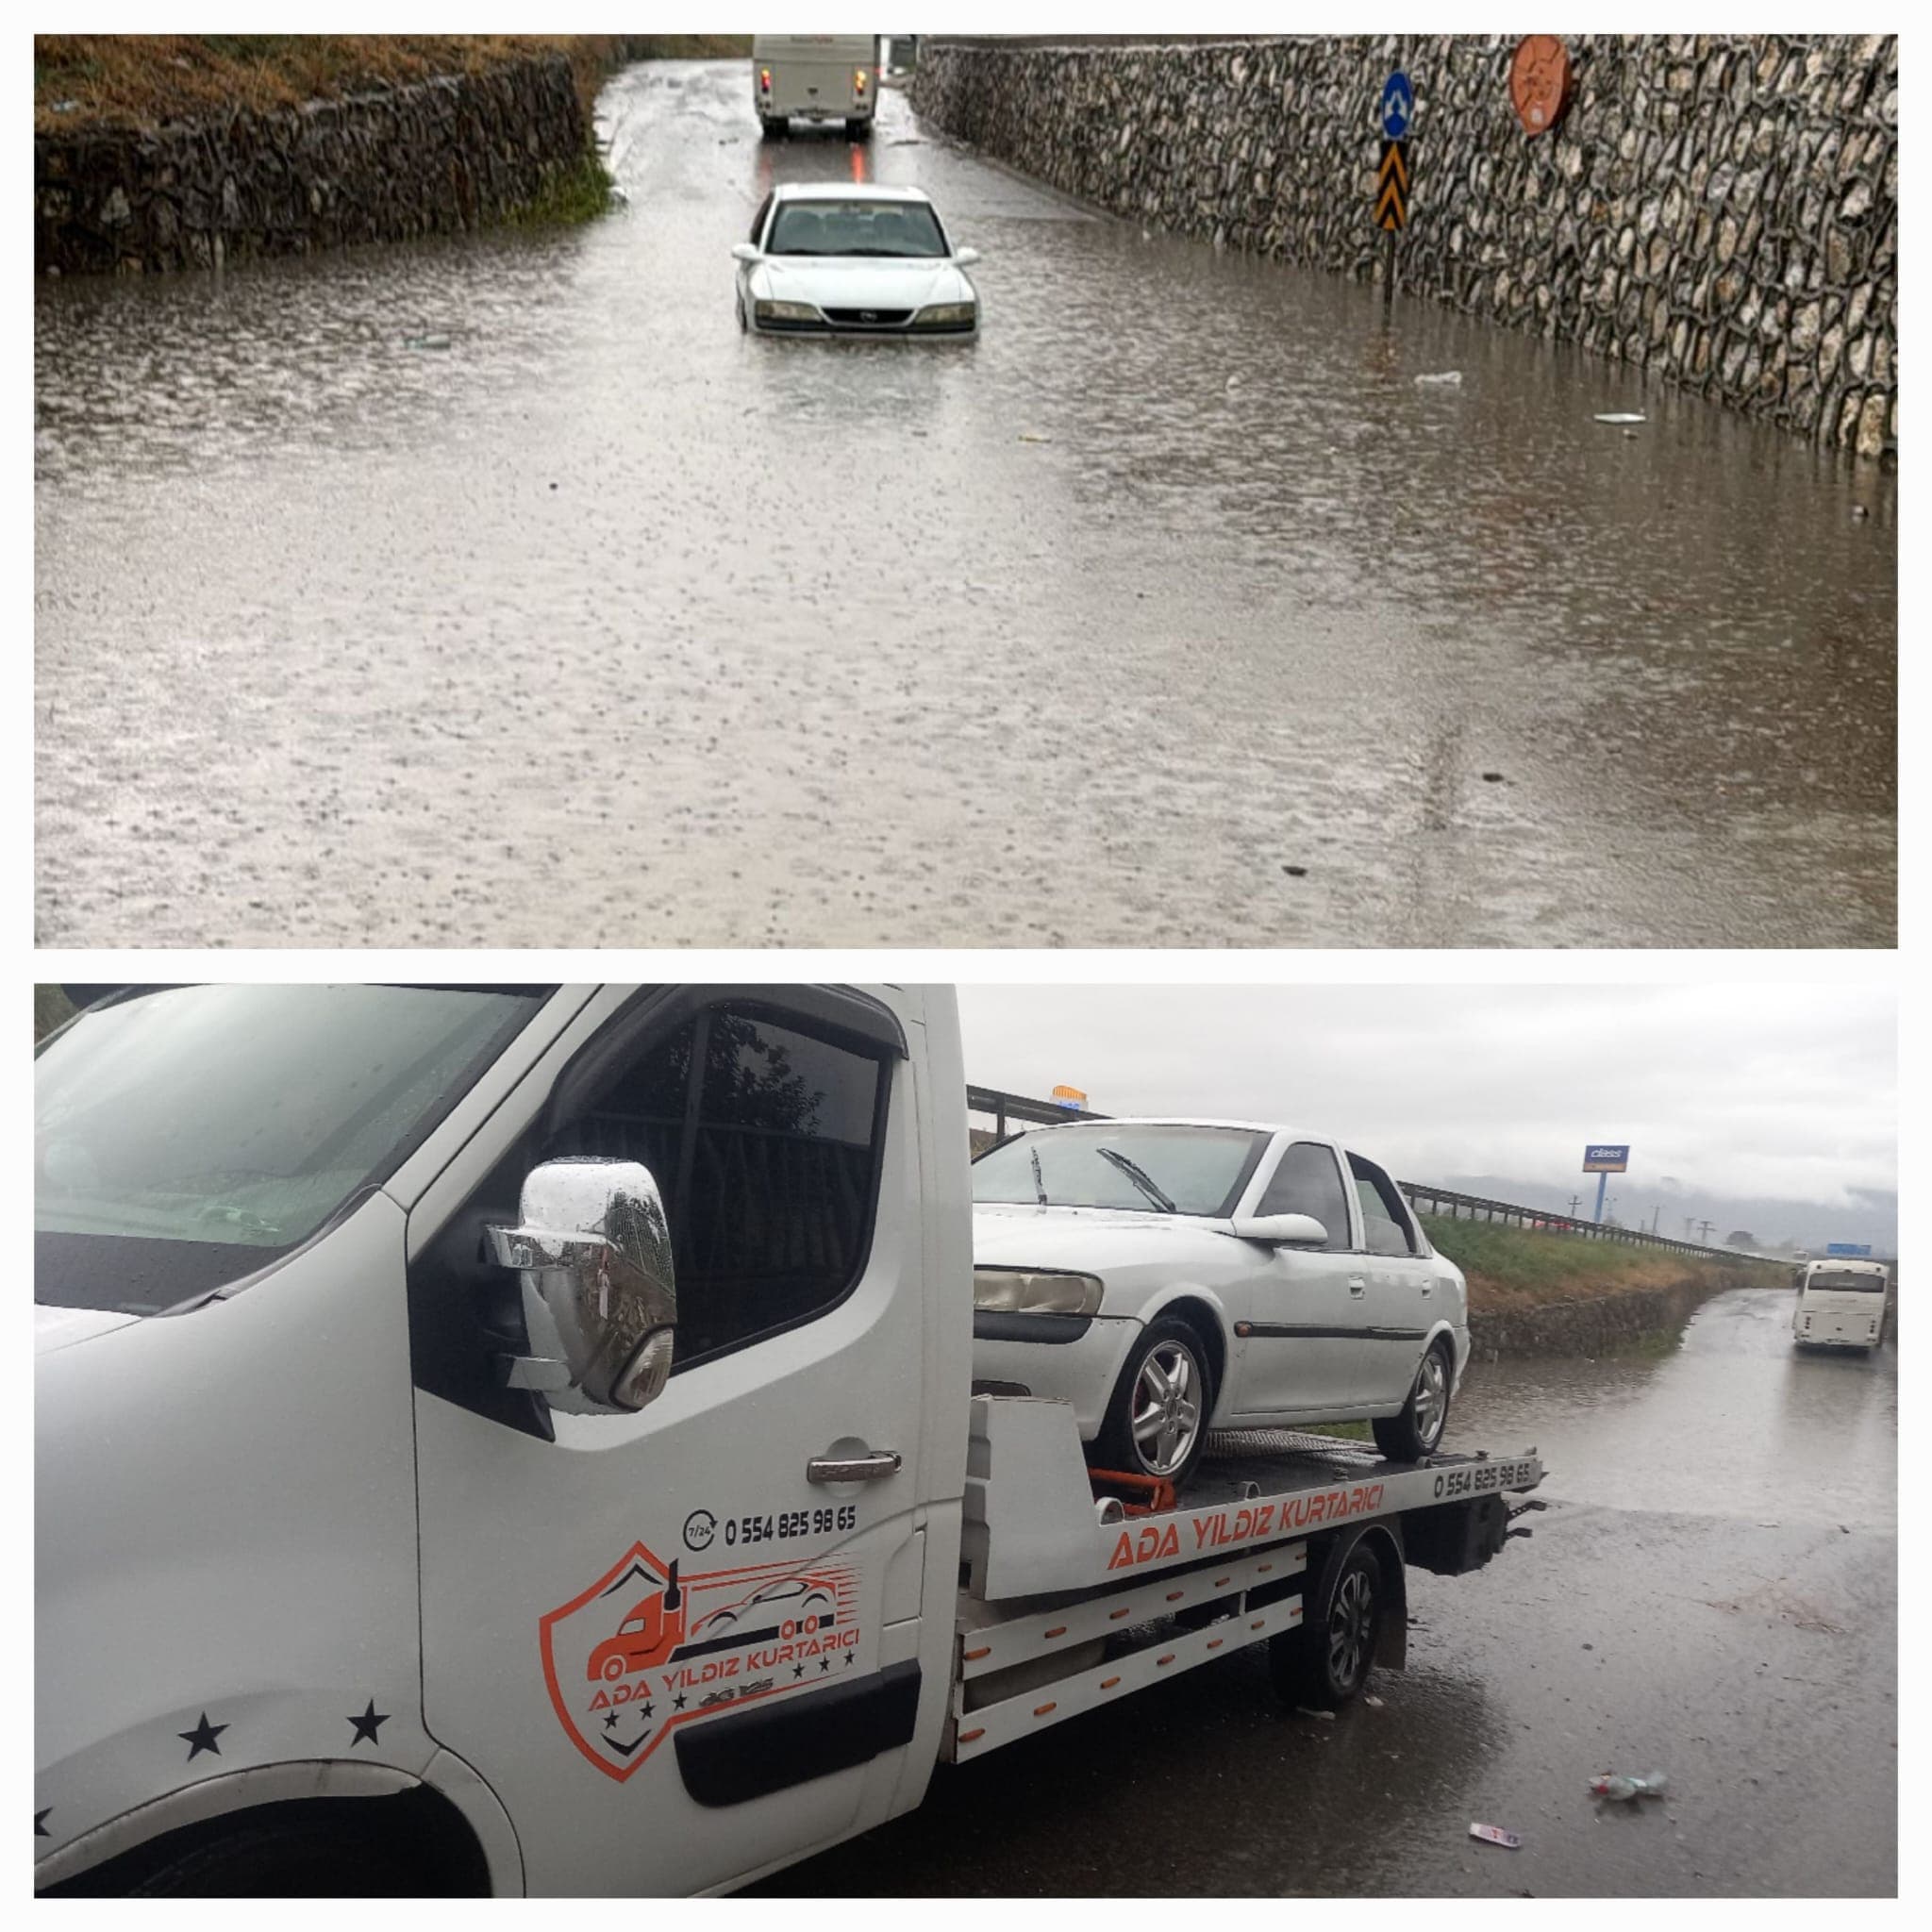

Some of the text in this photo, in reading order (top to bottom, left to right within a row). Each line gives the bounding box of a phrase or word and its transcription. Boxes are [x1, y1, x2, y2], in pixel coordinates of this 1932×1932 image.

[1435, 1475, 1443, 1498] 0
[1446, 1472, 1471, 1496] 554
[1474, 1467, 1497, 1491] 825
[688, 1525, 711, 1538] 7/24
[725, 1505, 856, 1546] 0 554 825 98 65
[1108, 1523, 1179, 1570] ADA
[1192, 1505, 1274, 1549] YILDIZ
[588, 1679, 652, 1711] ADA
[661, 1657, 740, 1691] YILDIZ
